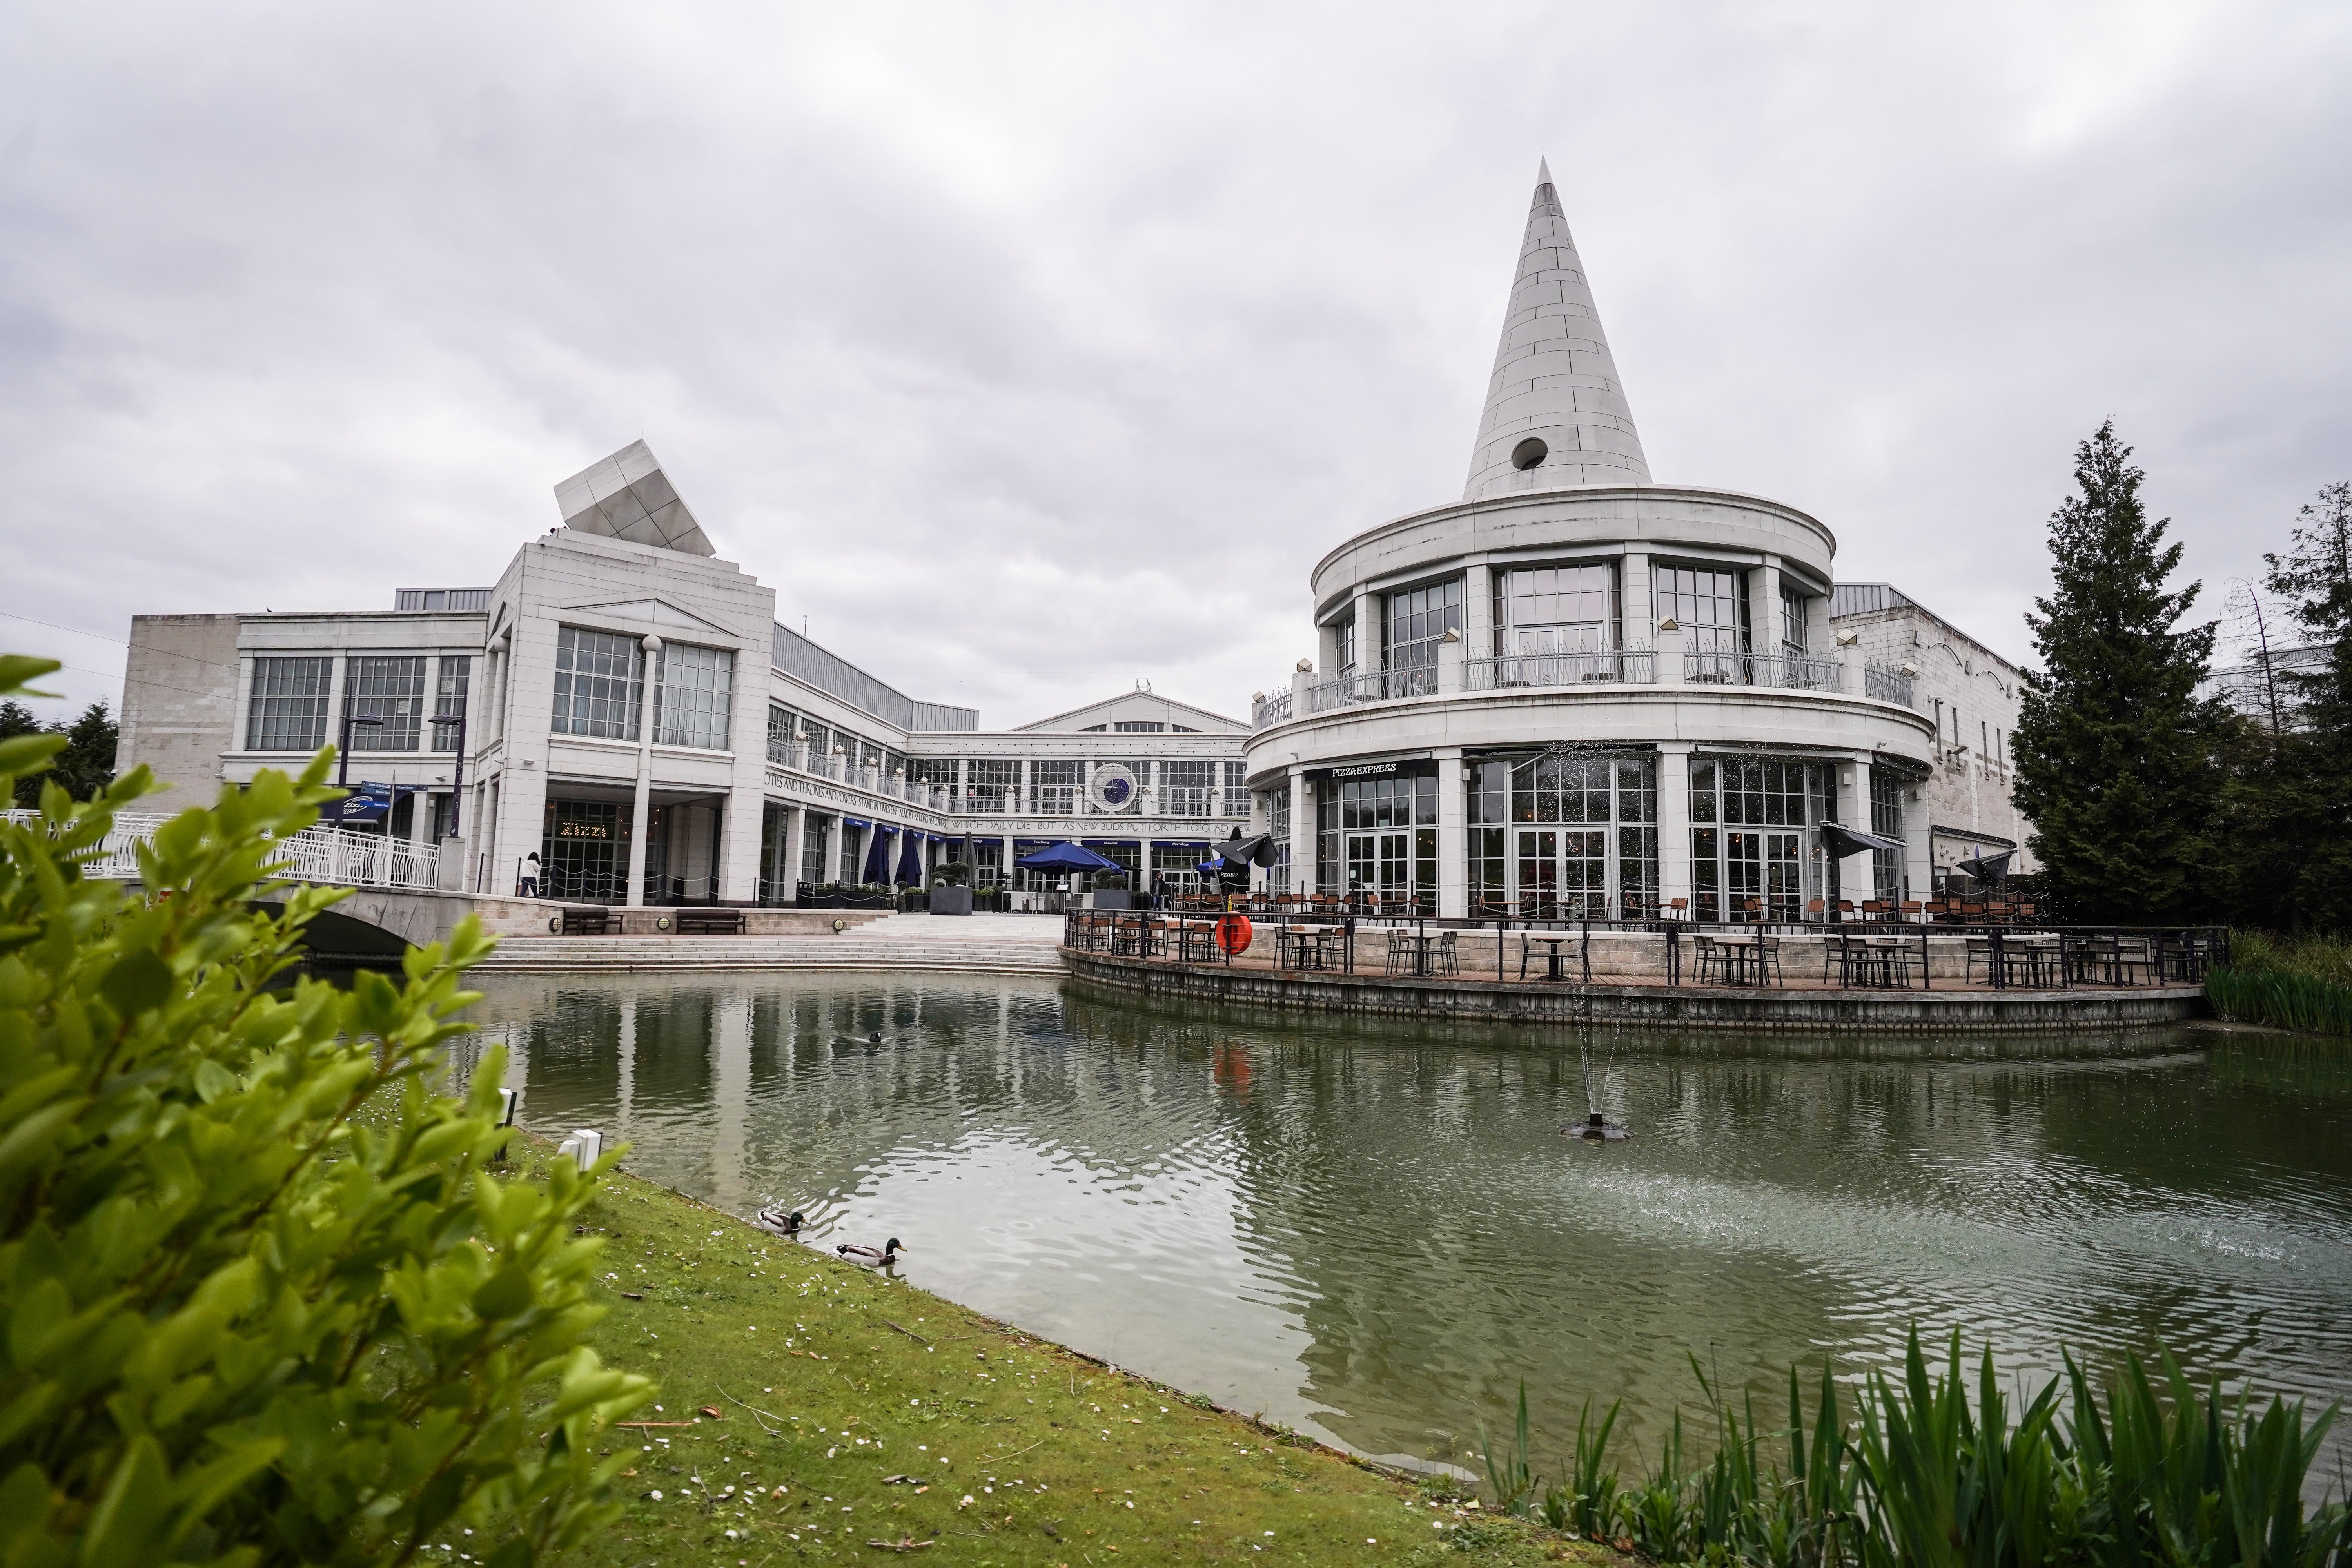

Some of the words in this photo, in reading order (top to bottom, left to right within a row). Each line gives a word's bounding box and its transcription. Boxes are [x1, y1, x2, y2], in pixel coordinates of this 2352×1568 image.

[764, 773, 782, 788] CITIES
[784, 779, 797, 791] AND
[799, 781, 824, 798] THRONES
[825, 789, 837, 801] AND
[837, 791, 857, 806] POWERS
[858, 798, 874, 809] STAND
[874, 801, 878, 811] IN
[899, 809, 914, 819] ALMOST
[914, 812, 919, 821] AS
[919, 814, 929, 824] LONG
[928, 816, 933, 825] AS
[952, 820, 983, 829] WHICH
[986, 821, 1013, 829] DAILY
[1017, 821, 1031, 829] DIE
[1038, 822, 1056, 830] BUT
[1077, 822, 1098, 831] NEW
[1149, 823, 1181, 831] FORTH
[1184, 824, 1199, 832] TO
[1201, 824, 1229, 832] GLAD
